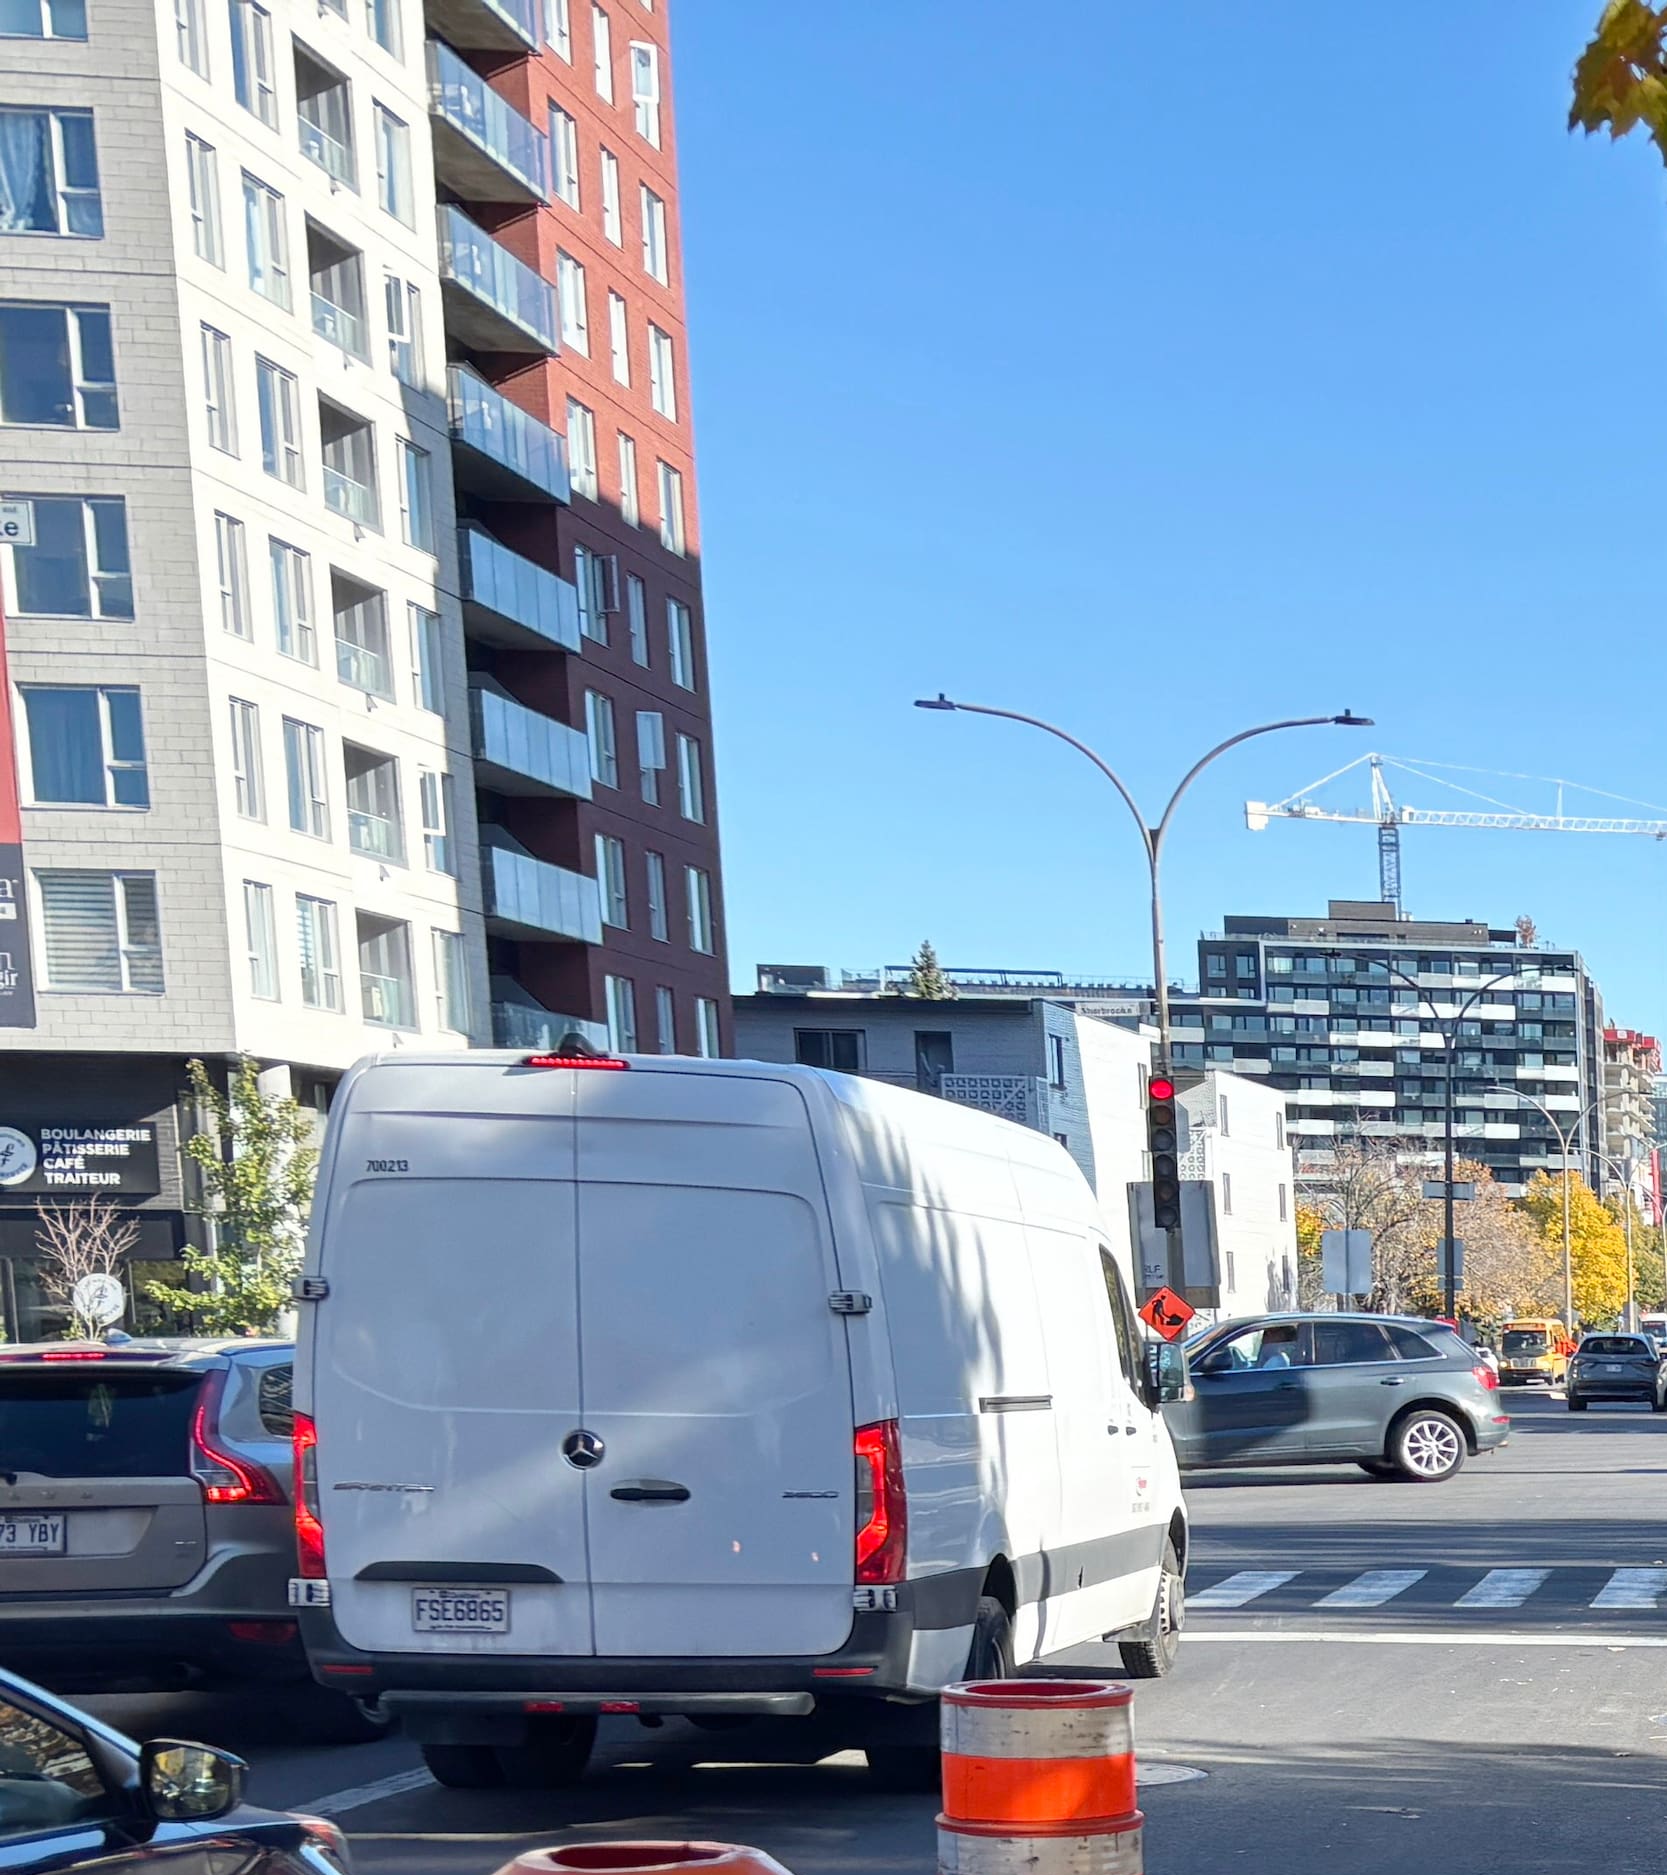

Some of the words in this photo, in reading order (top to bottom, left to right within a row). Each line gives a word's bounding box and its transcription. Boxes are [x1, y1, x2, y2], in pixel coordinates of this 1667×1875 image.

[40, 1128, 151, 1141] BOULANGERIE
[42, 1141, 130, 1155] PÂTISSERIE
[43, 1155, 85, 1169] CAFÉ
[44, 1172, 121, 1185] TRAITEUR
[28, 1523, 60, 1543] YBY
[415, 1599, 504, 1622] FSE6865
